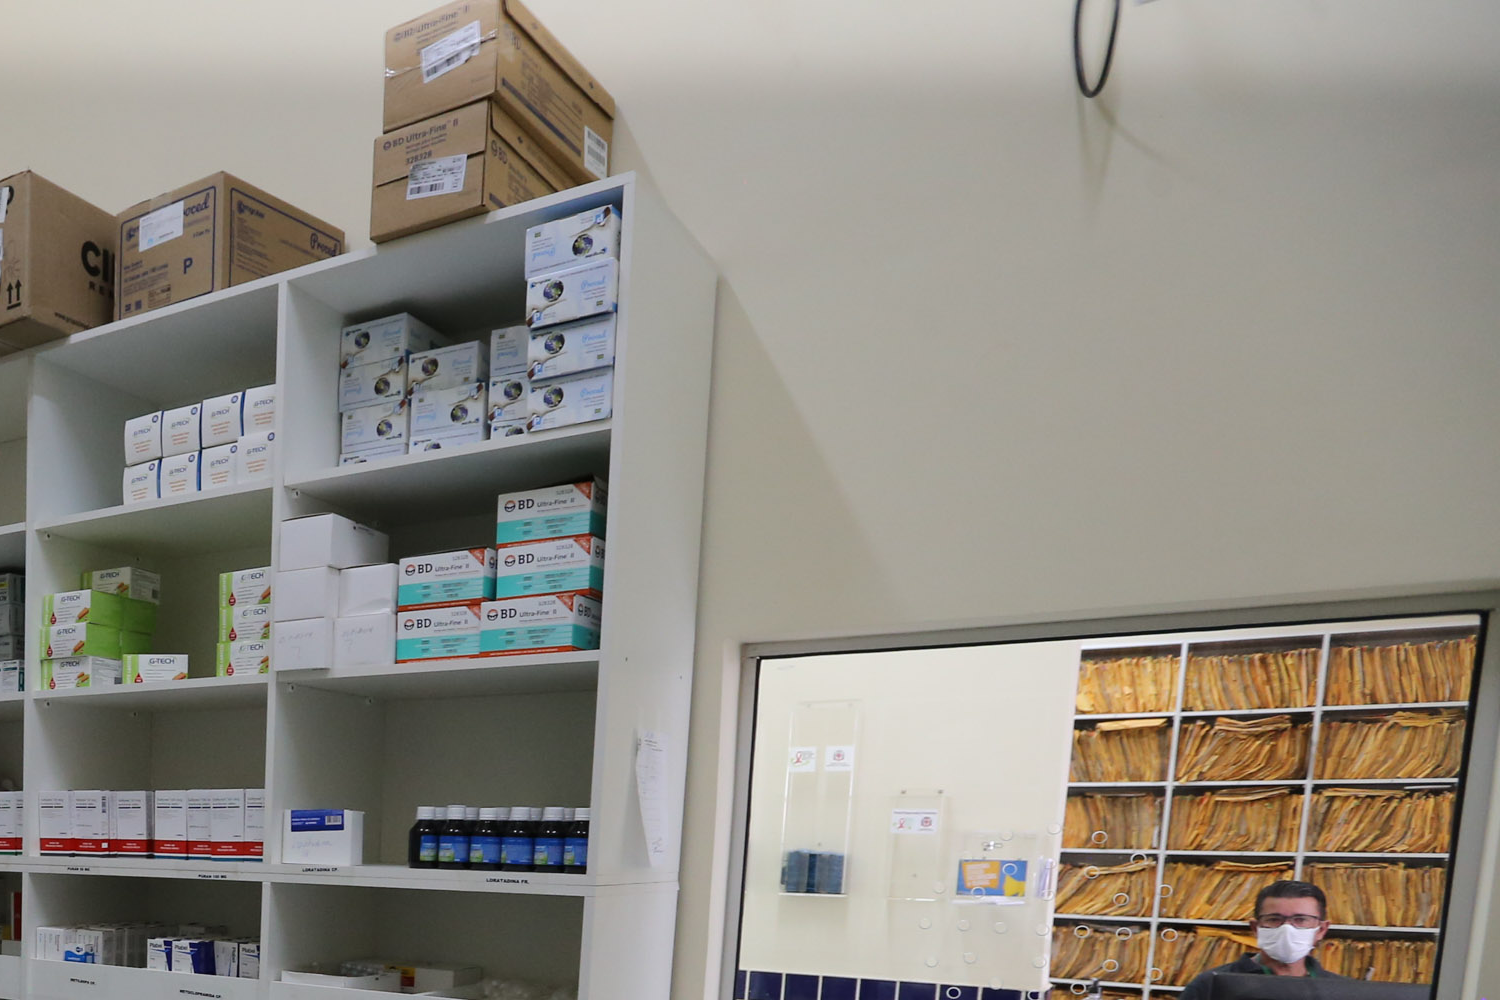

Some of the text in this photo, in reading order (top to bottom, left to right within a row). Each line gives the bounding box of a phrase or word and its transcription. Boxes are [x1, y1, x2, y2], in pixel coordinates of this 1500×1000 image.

[392, 124, 447, 148] BD Ultra-Fine
[183, 258, 193, 274] P
[518, 499, 567, 510] BD Ultra-Fine
[518, 553, 567, 564] BD Ultra-Fine
[417, 563, 462, 574] BD Ultra-Fine
[500, 608, 549, 619] BD Ultra-Fine
[416, 618, 462, 629] BD Ultra-Fine
[57, 628, 76, 636] G-TECH
